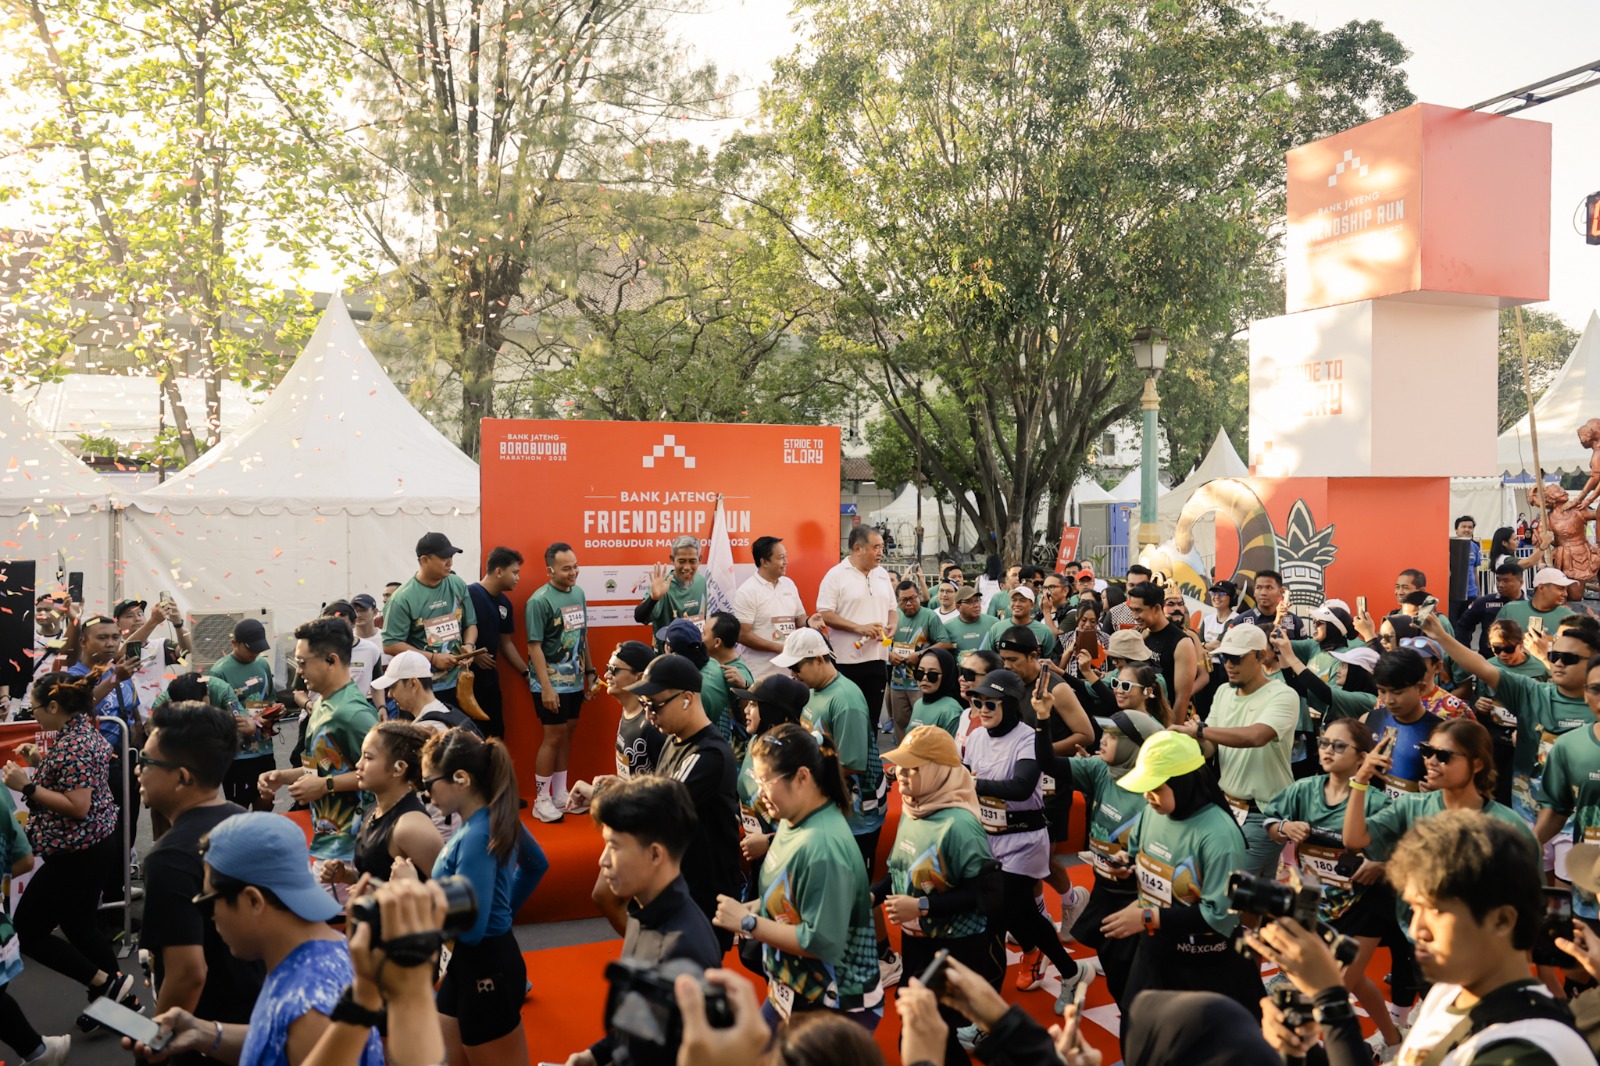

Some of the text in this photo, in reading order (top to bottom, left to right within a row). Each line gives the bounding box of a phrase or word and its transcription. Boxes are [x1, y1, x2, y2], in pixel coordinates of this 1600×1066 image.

[1318, 192, 1380, 216] BANK JATENG
[1377, 199, 1404, 225] RUN
[1325, 359, 1342, 380] TO
[500, 441, 567, 455] BOROBUDUR
[784, 438, 823, 448] STRIDE TO
[784, 449, 823, 464] GLORY
[620, 491, 717, 505] BANK JATENG
[583, 510, 705, 534] FRIENDSHIP
[584, 539, 653, 548] BOROBUDUR
[728, 538, 749, 547] 025
[435, 623, 455, 634] 2121
[980, 808, 998, 820] 1331
[1141, 871, 1163, 890] 1142
